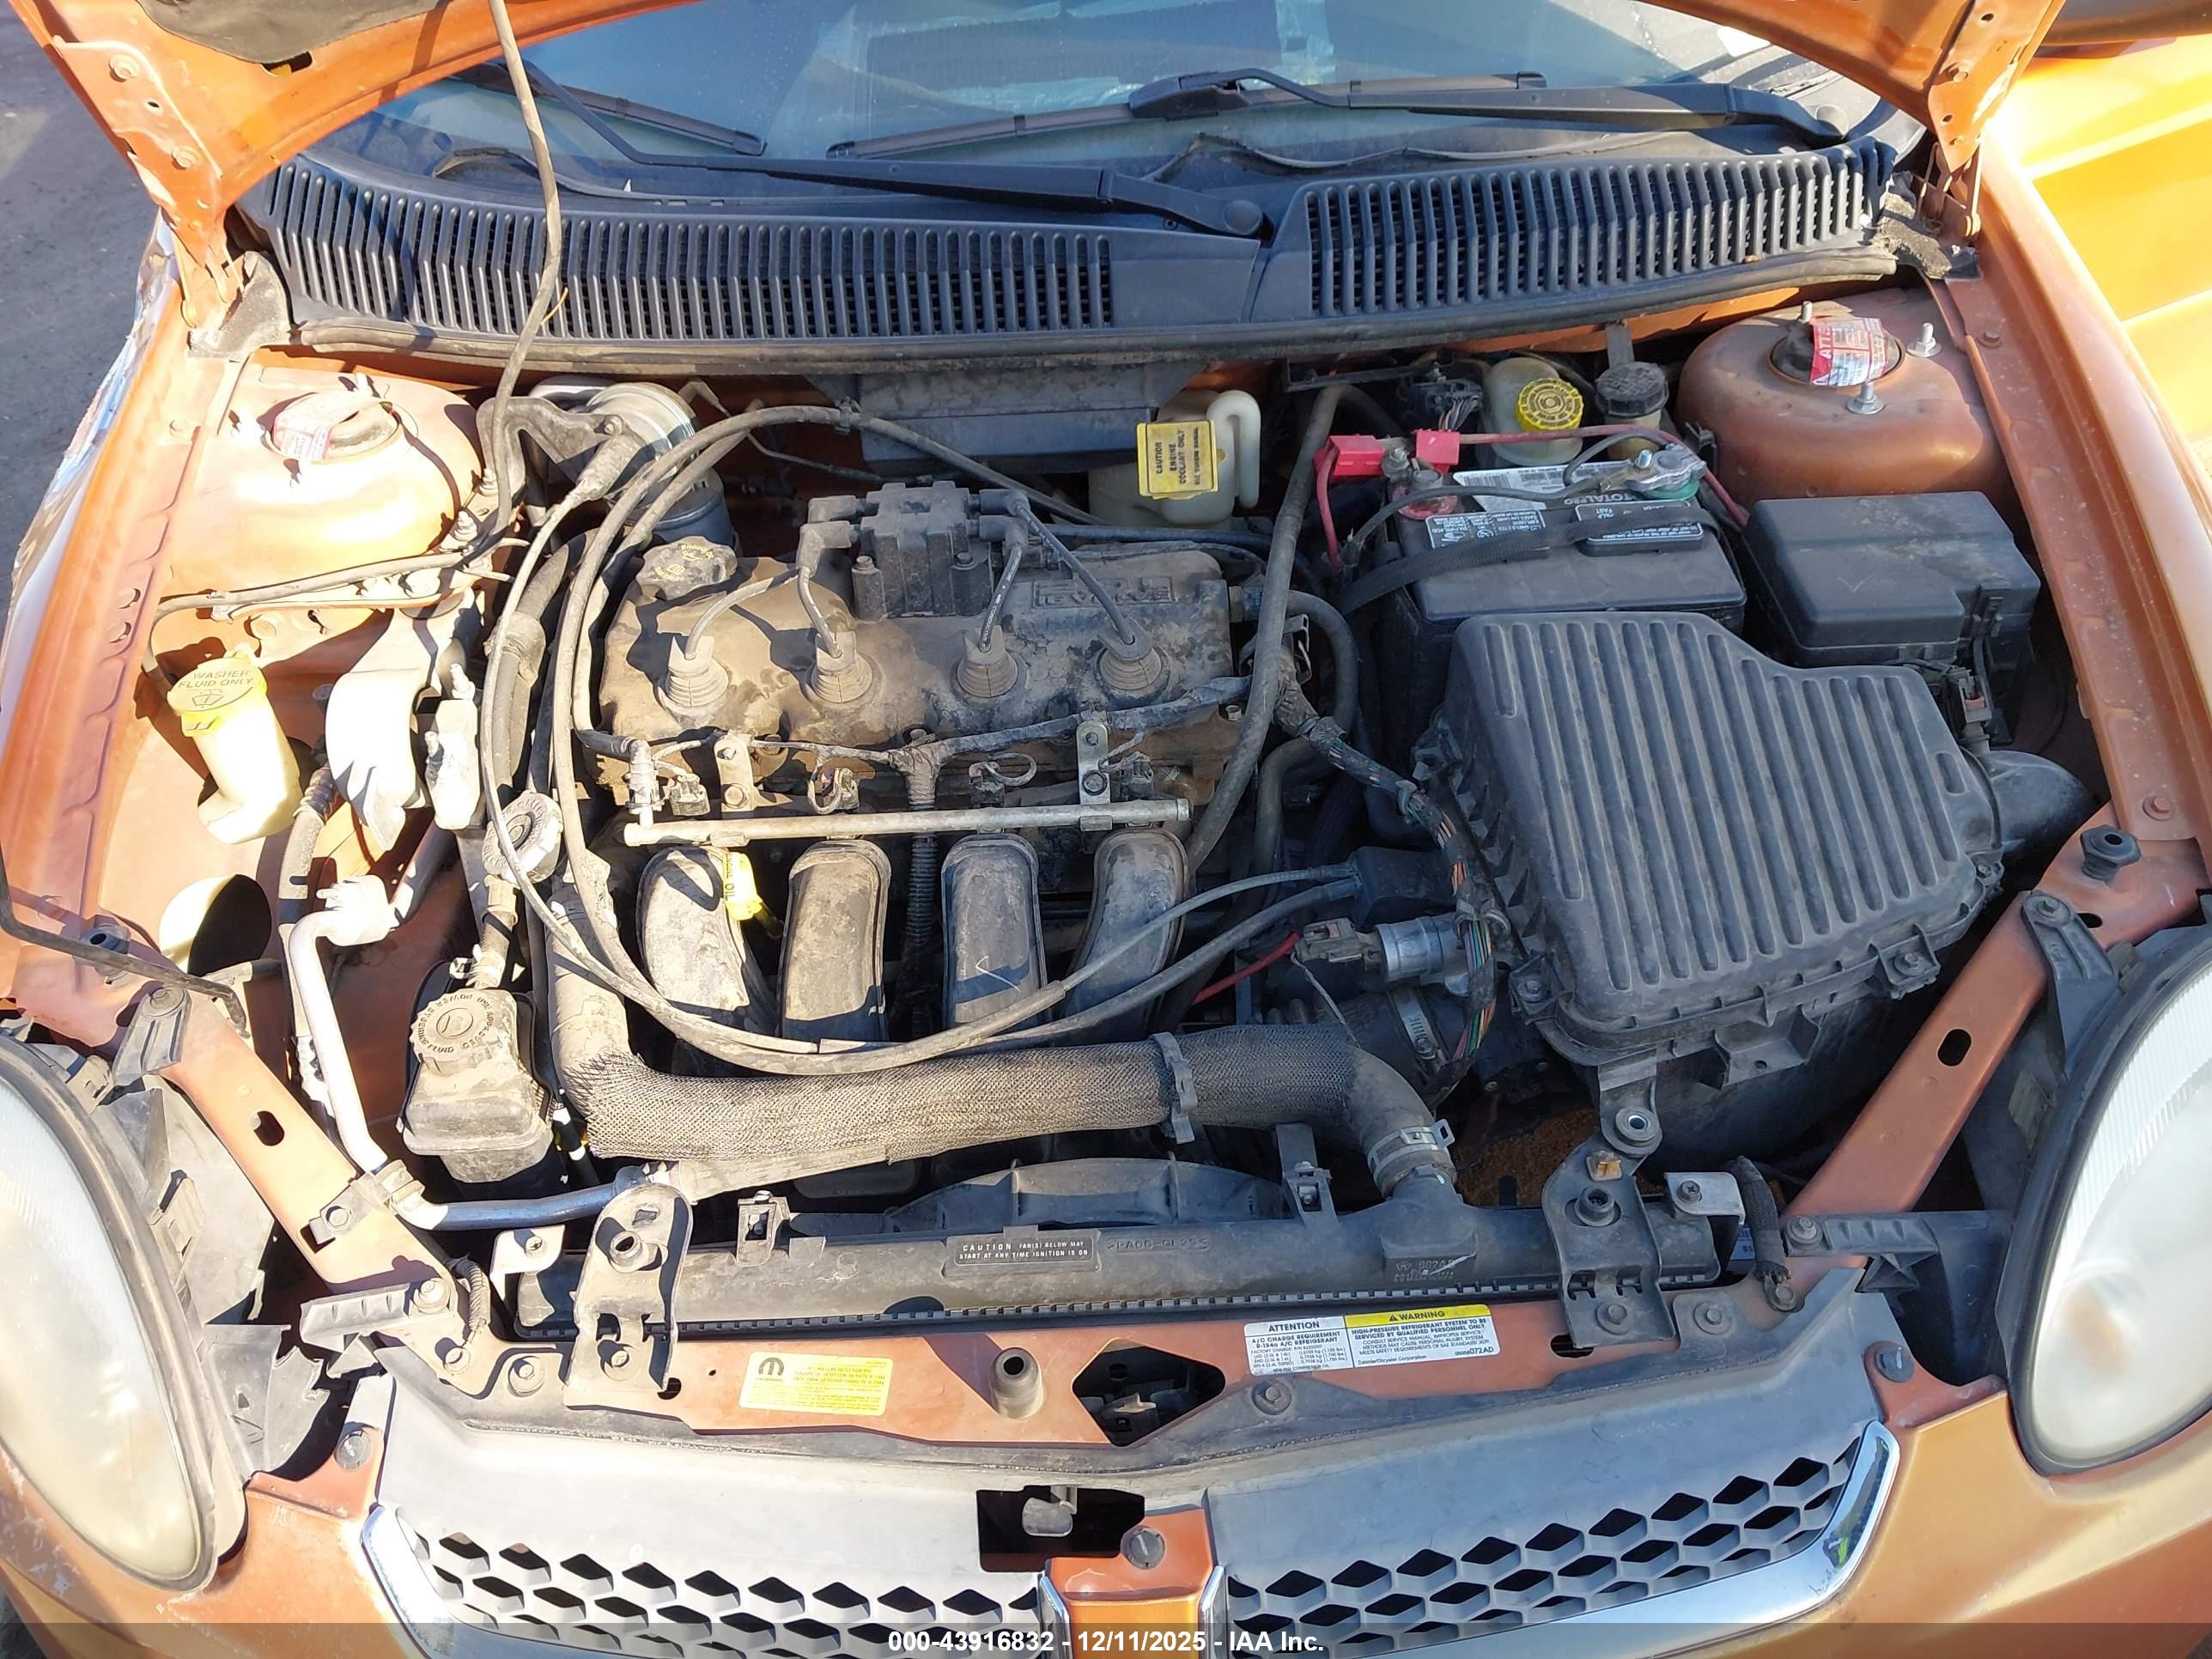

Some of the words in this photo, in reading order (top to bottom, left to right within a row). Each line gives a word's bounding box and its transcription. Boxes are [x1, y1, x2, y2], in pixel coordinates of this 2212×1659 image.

[1177, 429, 1185, 447] ONLY
[1169, 443, 1177, 471] ENGINE
[1564, 493, 1635, 505] TOTALPRO
[193, 670, 249, 679] WASHER
[220, 677, 254, 686] ONLY
[725, 883, 735, 902] OIL
[477, 997, 492, 1011] USE
[963, 1244, 1012, 1252] CAUTION
[1398, 1311, 1445, 1320] WARNING
[1269, 1321, 1320, 1332] ATTENTION
[1352, 1326, 1400, 1334] HIGH-PRESSURE
[1297, 1331, 1340, 1339] REQUIREMENT
[1294, 1337, 1338, 1345] REFRIGERANT
